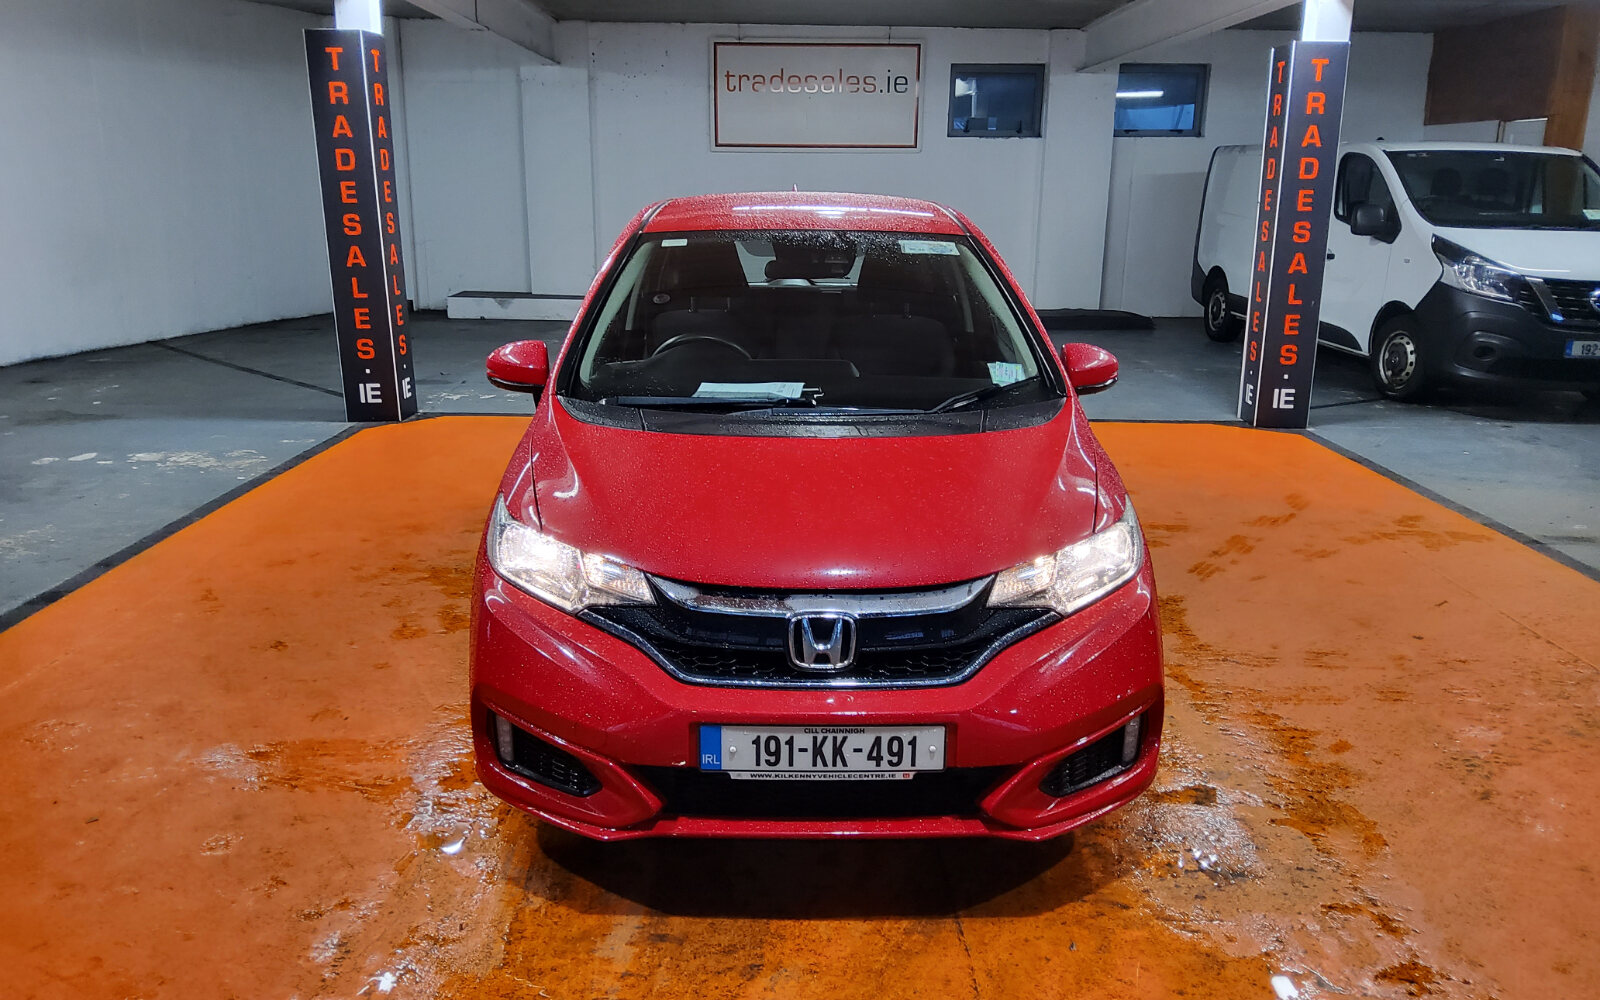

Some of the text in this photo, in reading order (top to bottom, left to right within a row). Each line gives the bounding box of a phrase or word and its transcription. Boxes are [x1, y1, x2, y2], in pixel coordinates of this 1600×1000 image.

[724, 67, 909, 94] tradesales.ie
[1581, 343, 1600, 355] 192
[702, 753, 721, 765] IRL
[751, 735, 918, 768] 191-KK-491
